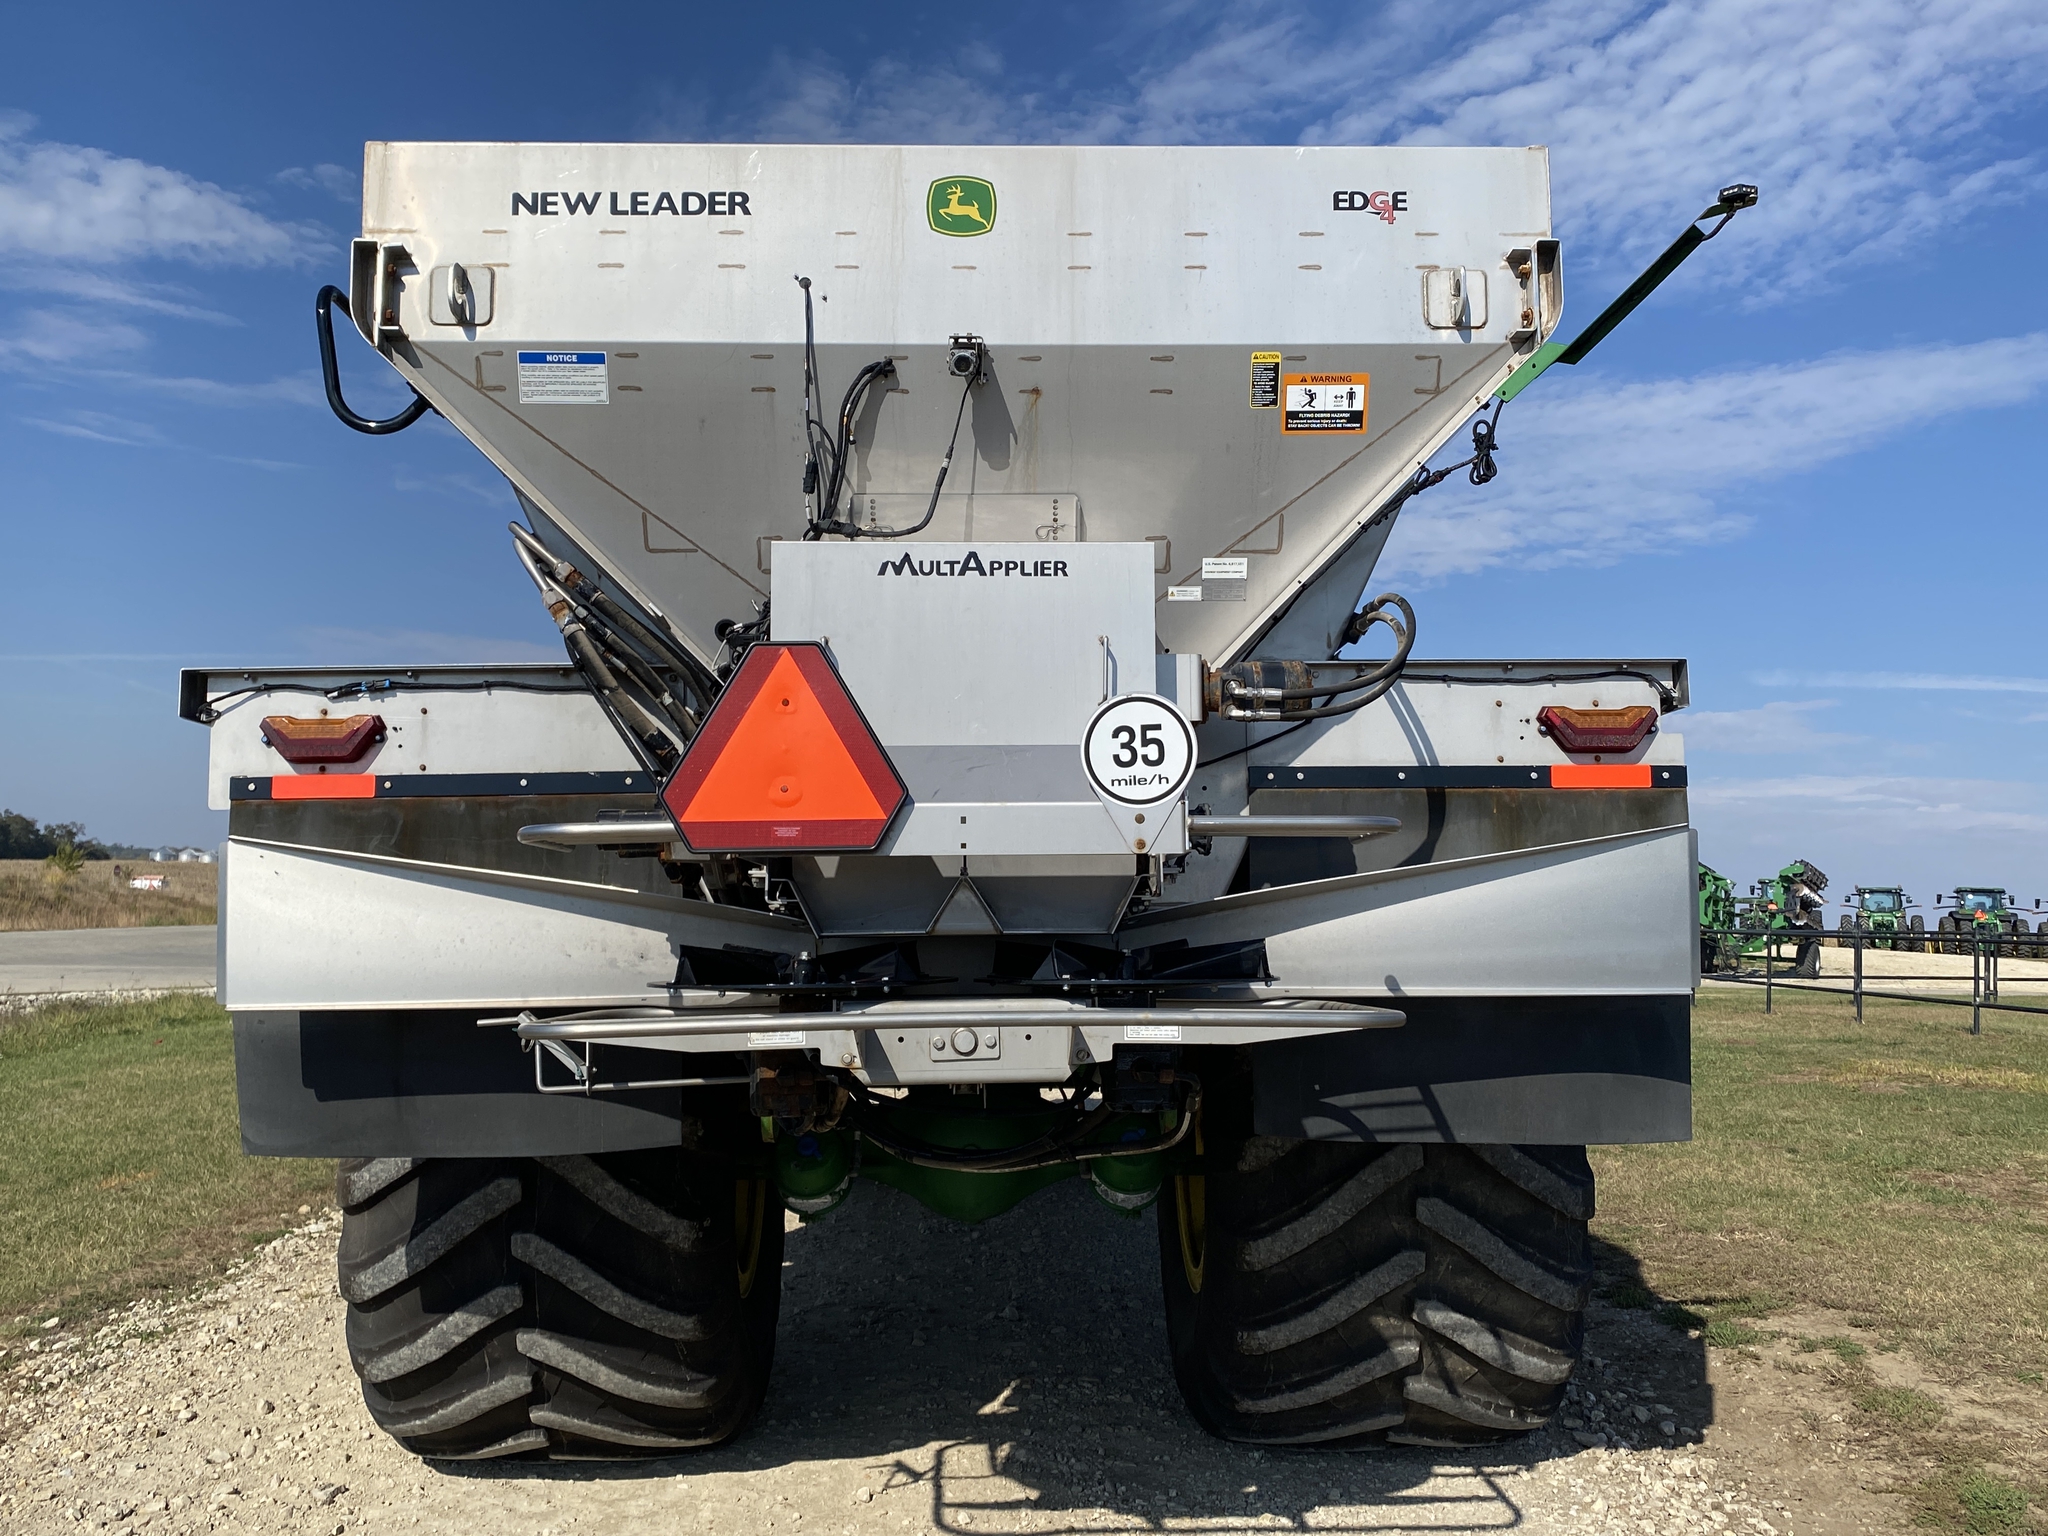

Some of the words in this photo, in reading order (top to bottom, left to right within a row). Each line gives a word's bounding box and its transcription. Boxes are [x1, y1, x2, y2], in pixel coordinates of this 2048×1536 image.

[511, 191, 602, 216] NEW
[609, 191, 752, 216] LEADER
[546, 354, 578, 362] NOTICE
[1111, 724, 1165, 768] 35
[1111, 774, 1170, 787] mile/h
